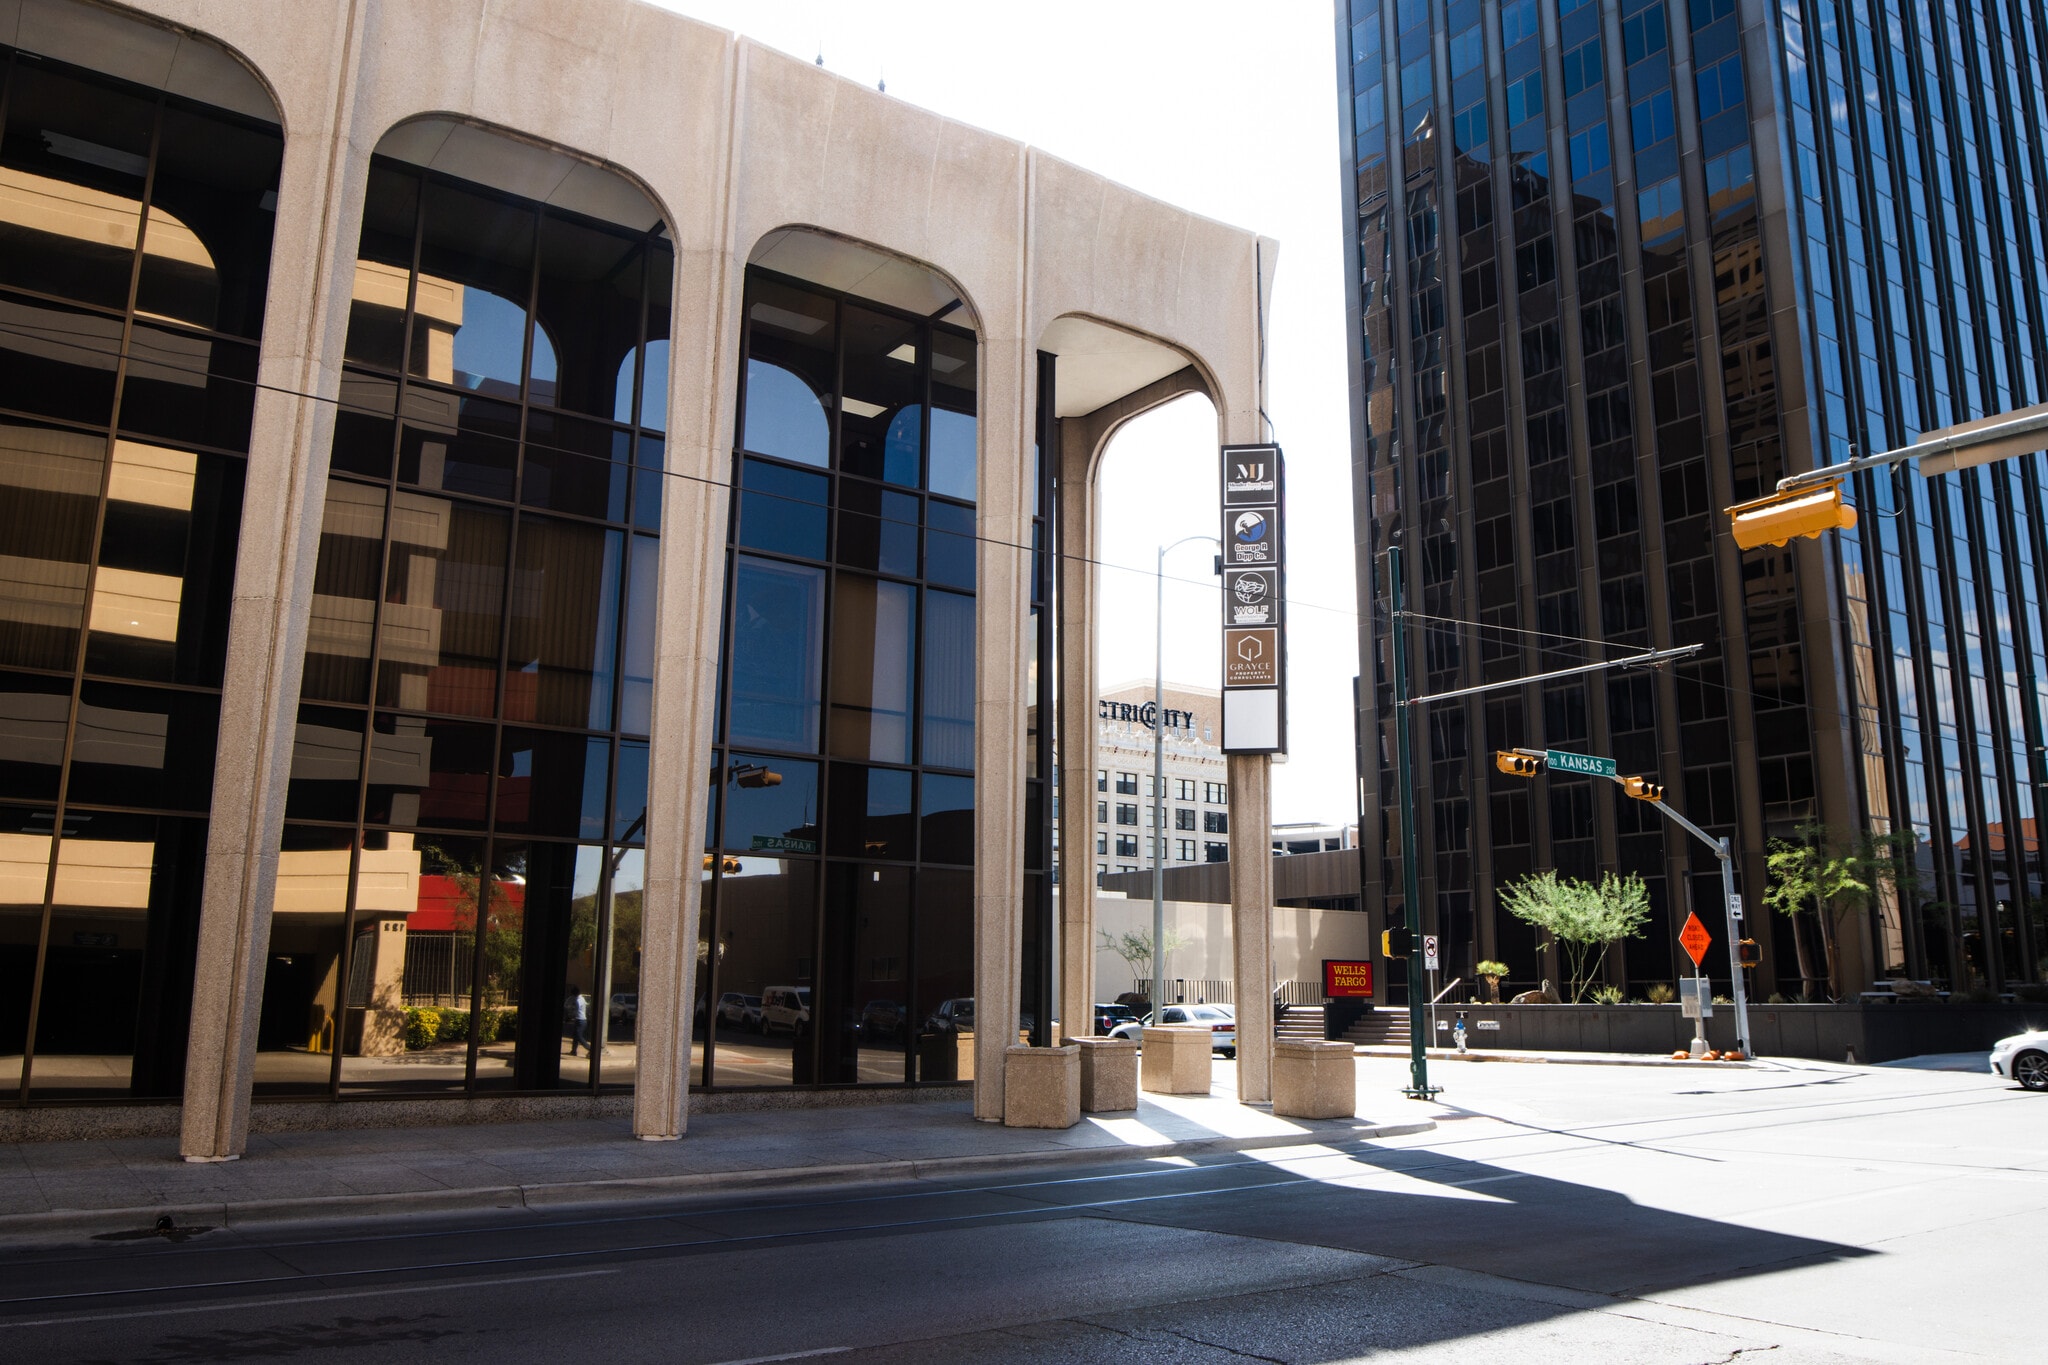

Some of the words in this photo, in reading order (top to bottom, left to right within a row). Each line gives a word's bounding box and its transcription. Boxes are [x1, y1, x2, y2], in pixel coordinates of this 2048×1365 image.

[1235, 543, 1260, 552] George
[1261, 542, 1268, 551] R
[1236, 552, 1253, 561] Dipp
[1254, 551, 1267, 560] Co.
[1234, 605, 1269, 615] WOLF
[1229, 662, 1271, 671] GRAYCE
[1560, 754, 1603, 773] KANSAS
[1606, 766, 1616, 775] 200
[1333, 965, 1366, 976] WELLS
[1334, 976, 1366, 987] FARGO
